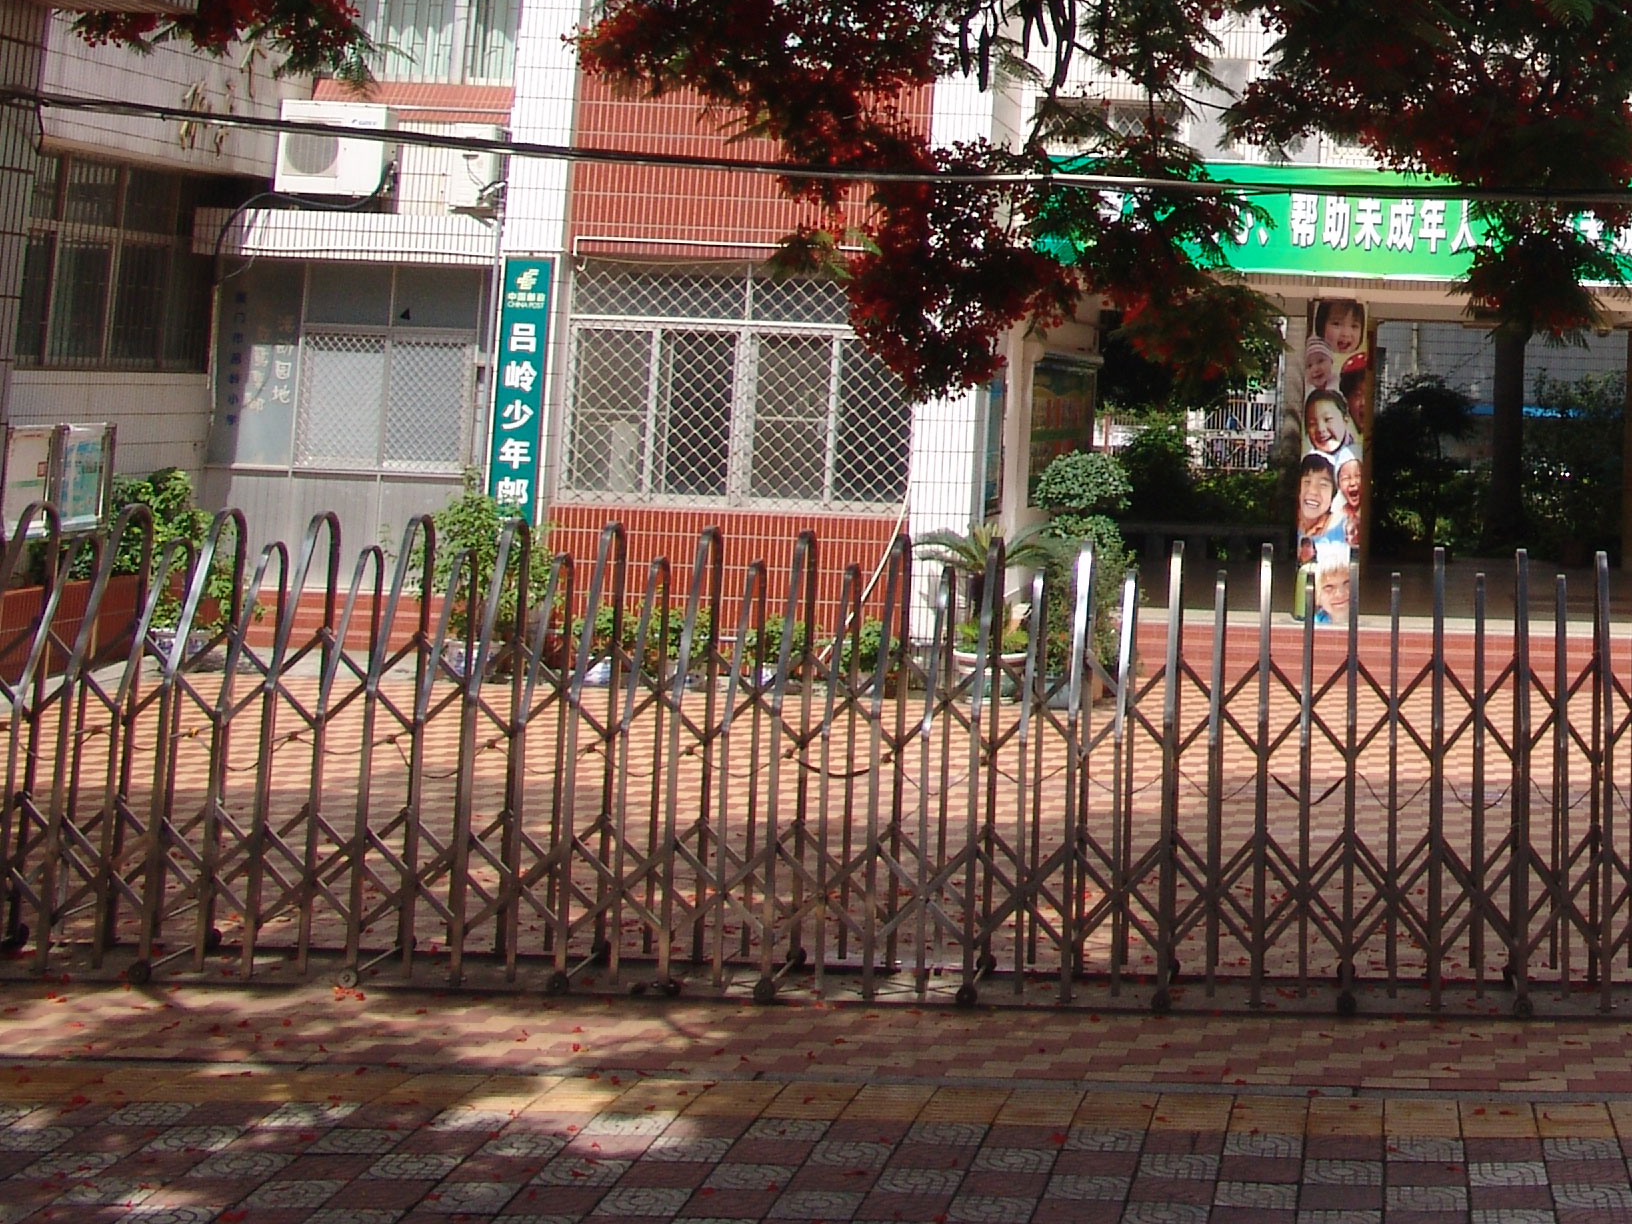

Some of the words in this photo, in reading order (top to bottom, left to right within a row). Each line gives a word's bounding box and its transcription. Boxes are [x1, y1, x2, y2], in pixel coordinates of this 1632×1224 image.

[494, 322, 538, 522] 吕岭少年邮
